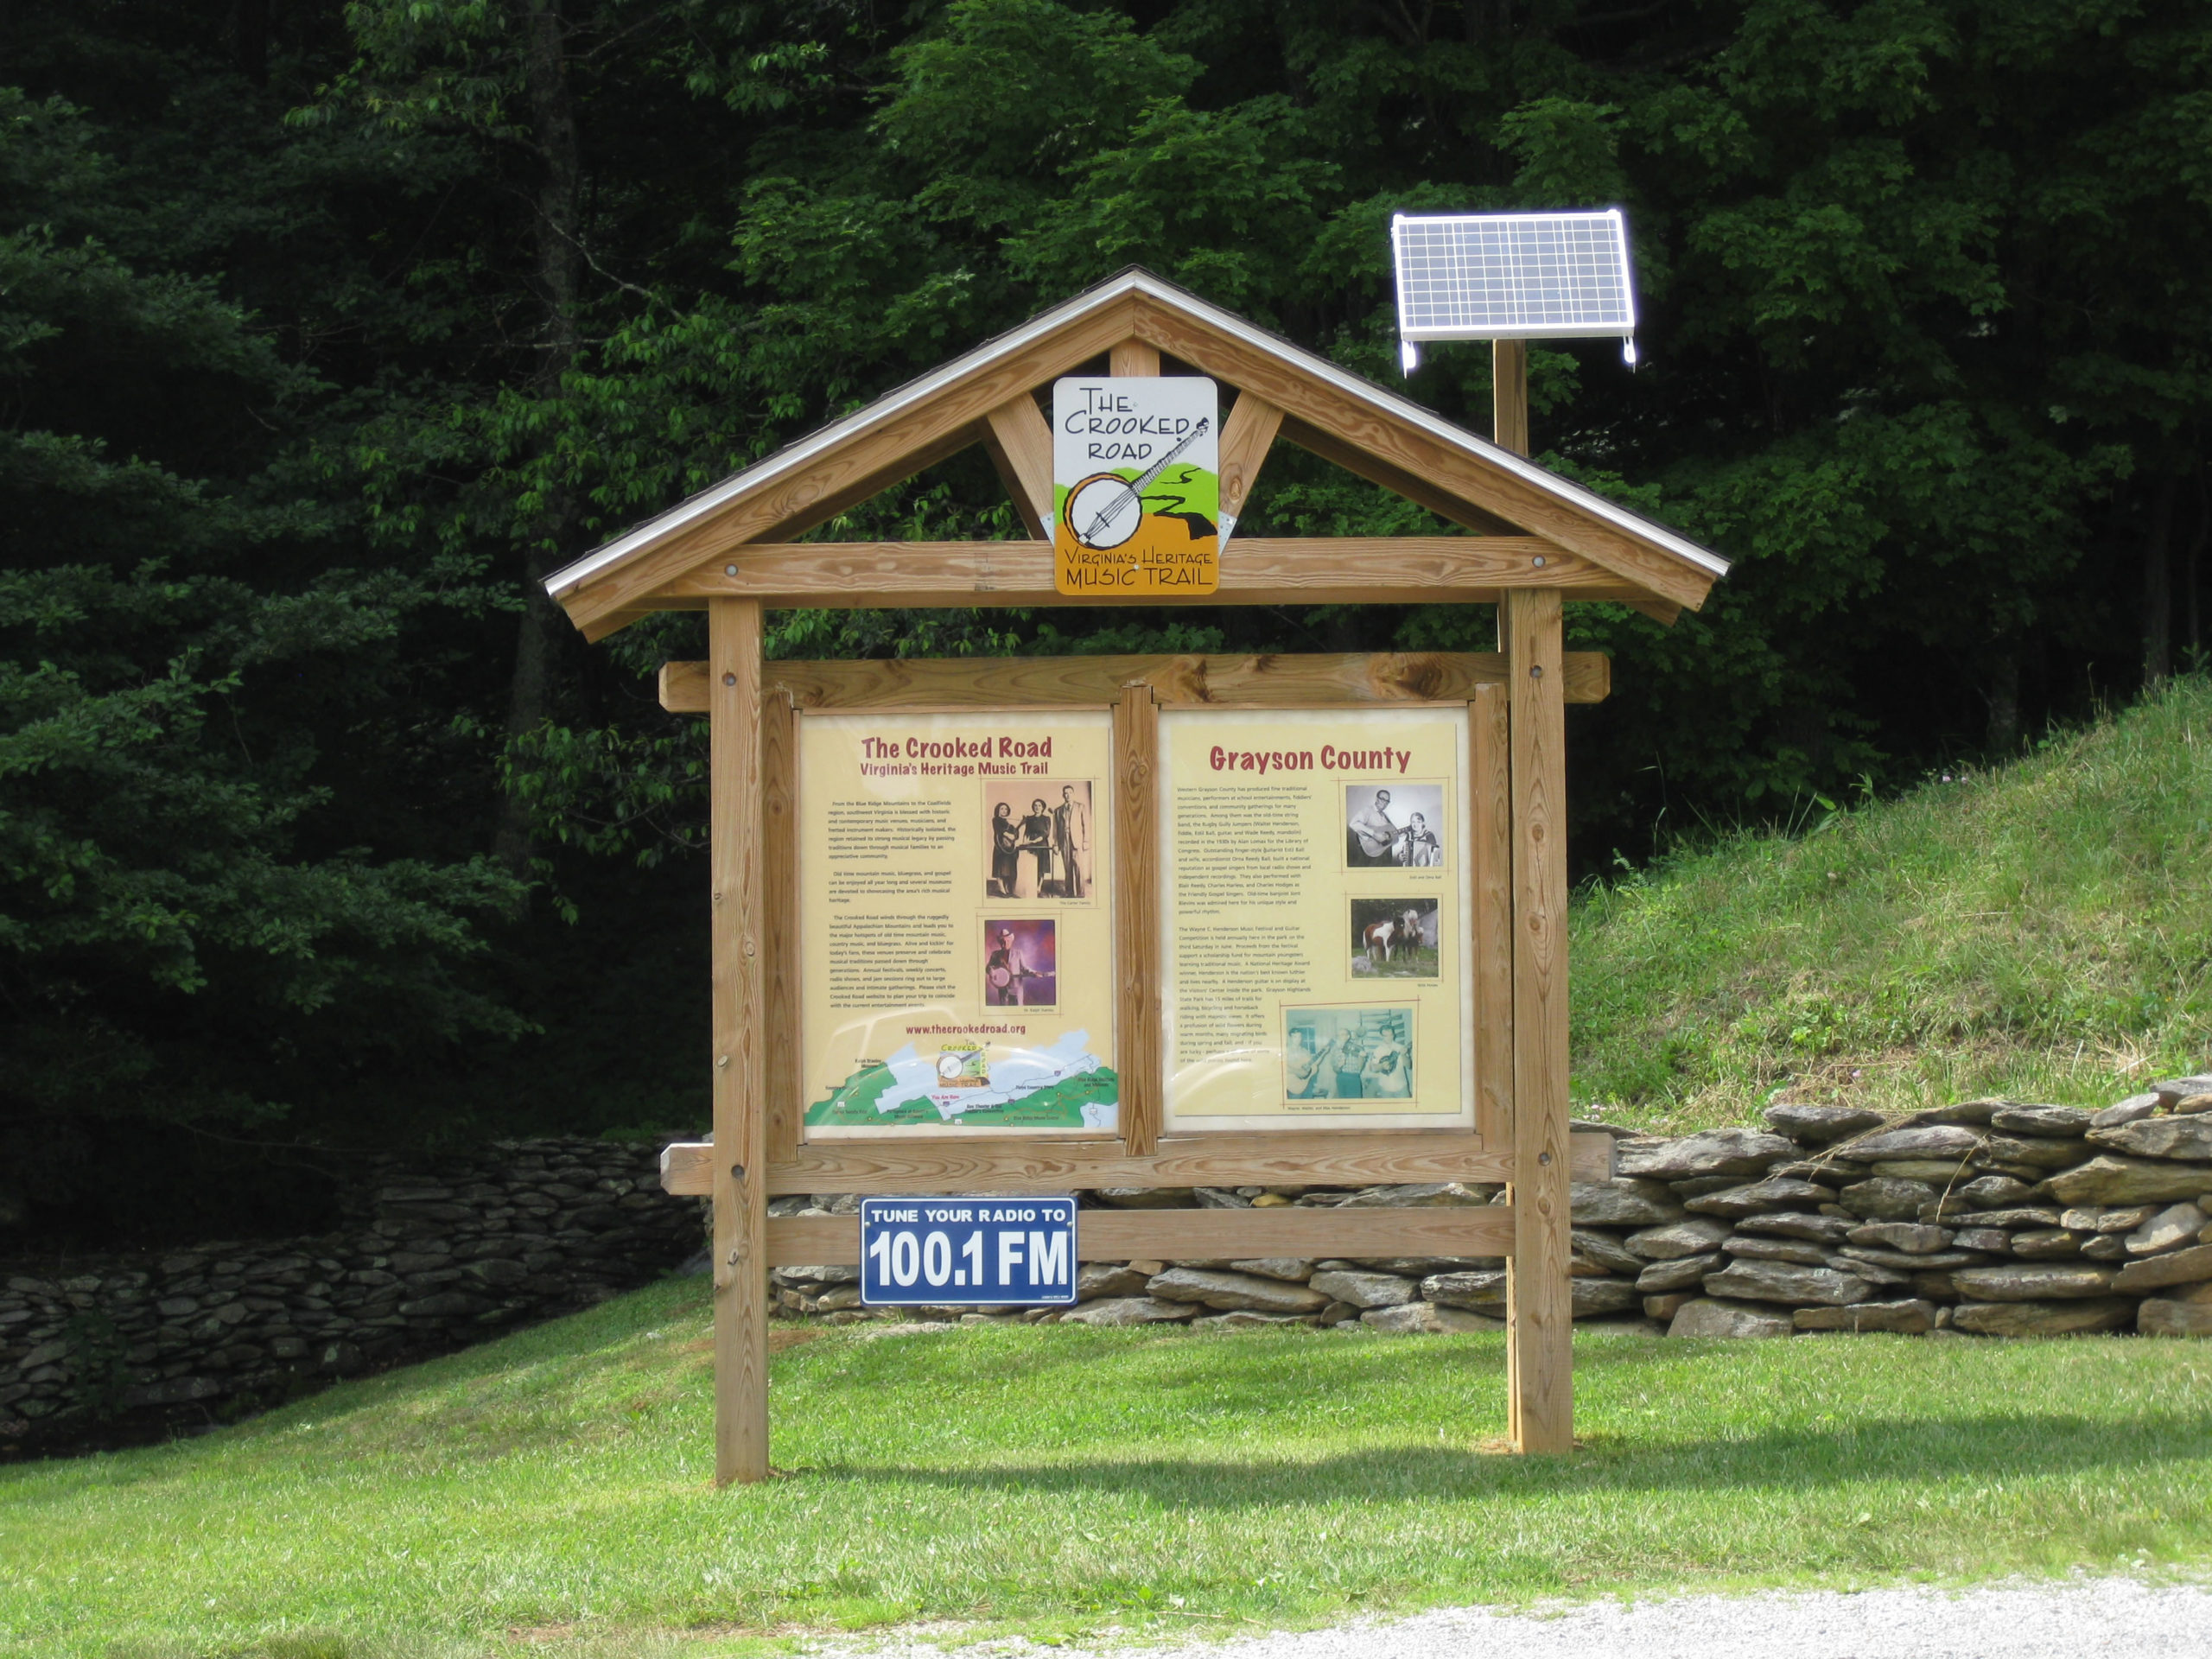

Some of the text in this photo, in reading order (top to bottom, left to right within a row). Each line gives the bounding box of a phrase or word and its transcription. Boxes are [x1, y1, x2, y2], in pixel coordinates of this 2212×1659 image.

[1079, 387, 1133, 415] THE
[1065, 410, 1189, 435] CROOKED
[1089, 442, 1152, 460] ROAD
[1065, 546, 1213, 564] VIRGINIA'S HERITAGE
[1067, 567, 1213, 589] MUSIC TRAIL
[861, 736, 1052, 759] The Crooked Road
[860, 761, 1048, 778] Virginia's Heritage Music Trail
[1210, 745, 1411, 775] Grayson County
[906, 1024, 1027, 1036] www.thecrookedroad.org
[871, 1209, 1066, 1223] TUNE YOUR RADIO TO
[869, 1230, 1068, 1287] 100.1 FM
